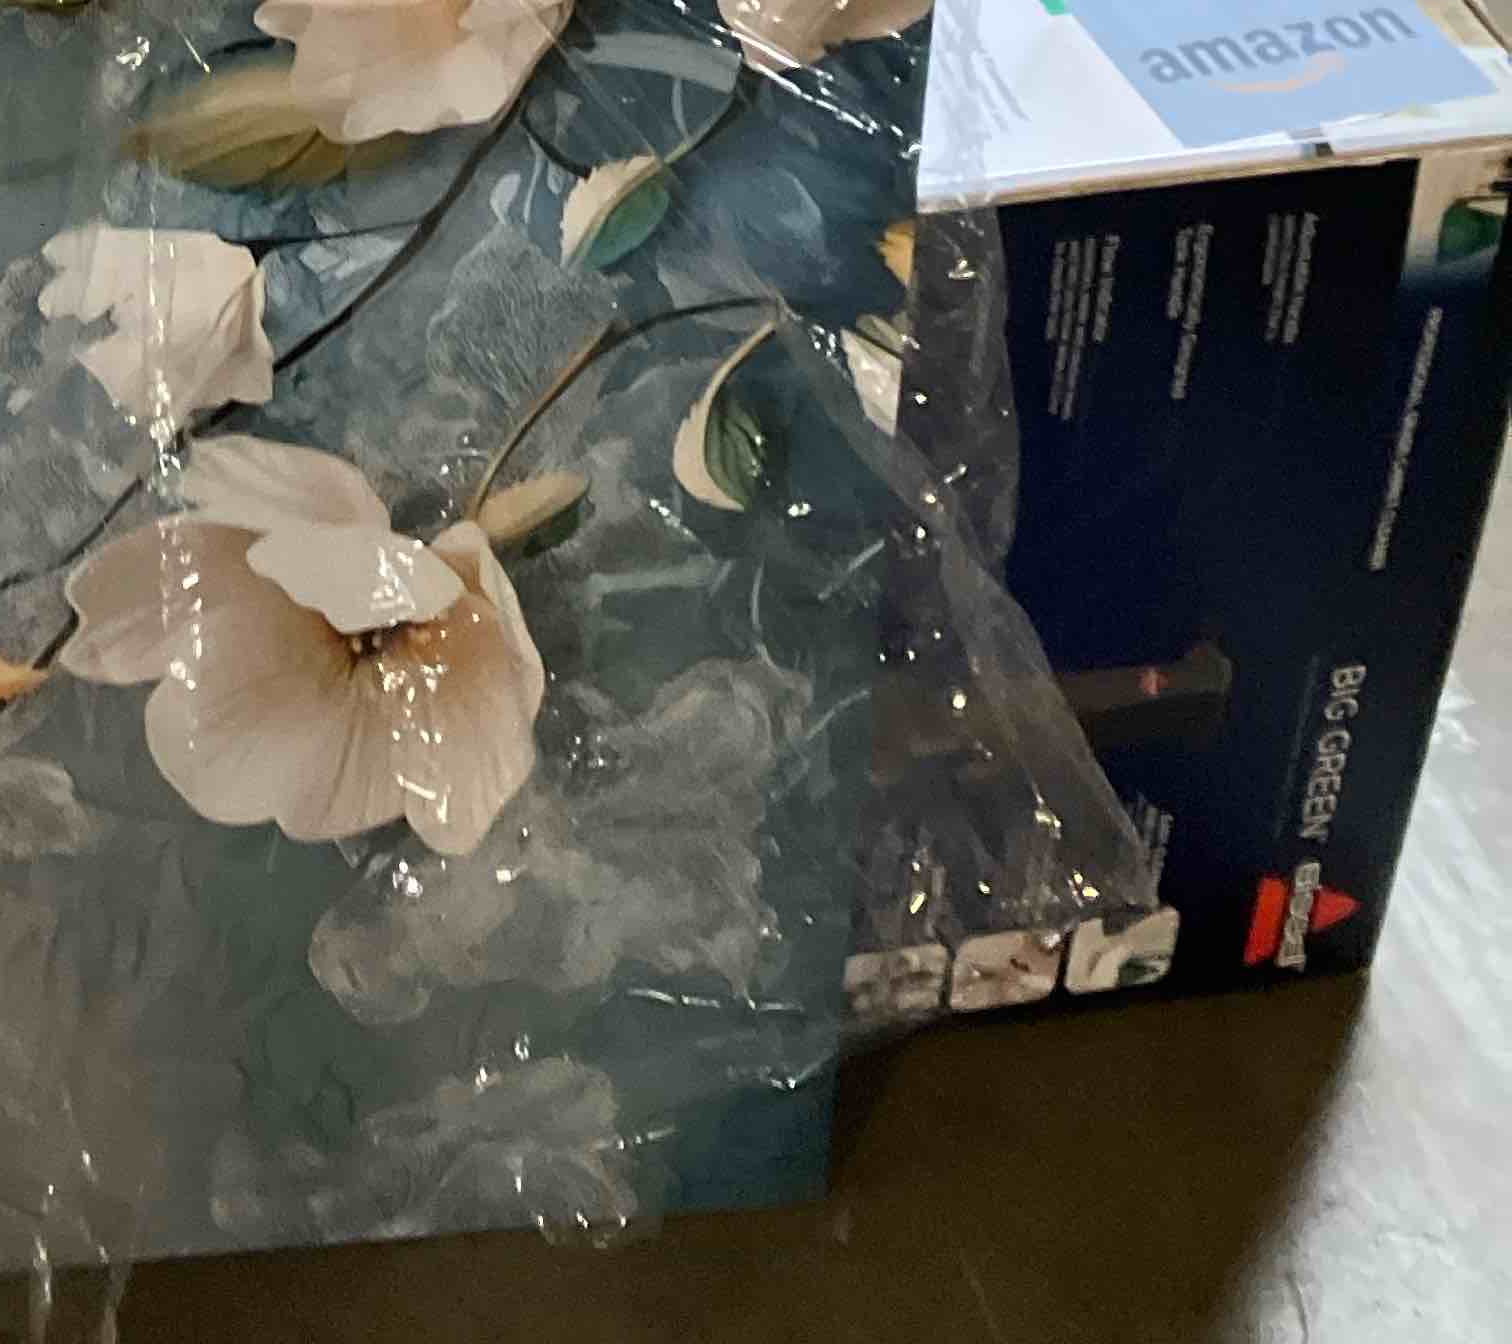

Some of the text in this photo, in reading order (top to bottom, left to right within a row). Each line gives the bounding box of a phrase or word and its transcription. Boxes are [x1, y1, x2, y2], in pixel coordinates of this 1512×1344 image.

[1139, 6, 1417, 84] amazon
[1299, 664, 1367, 843] BIG GREEN
